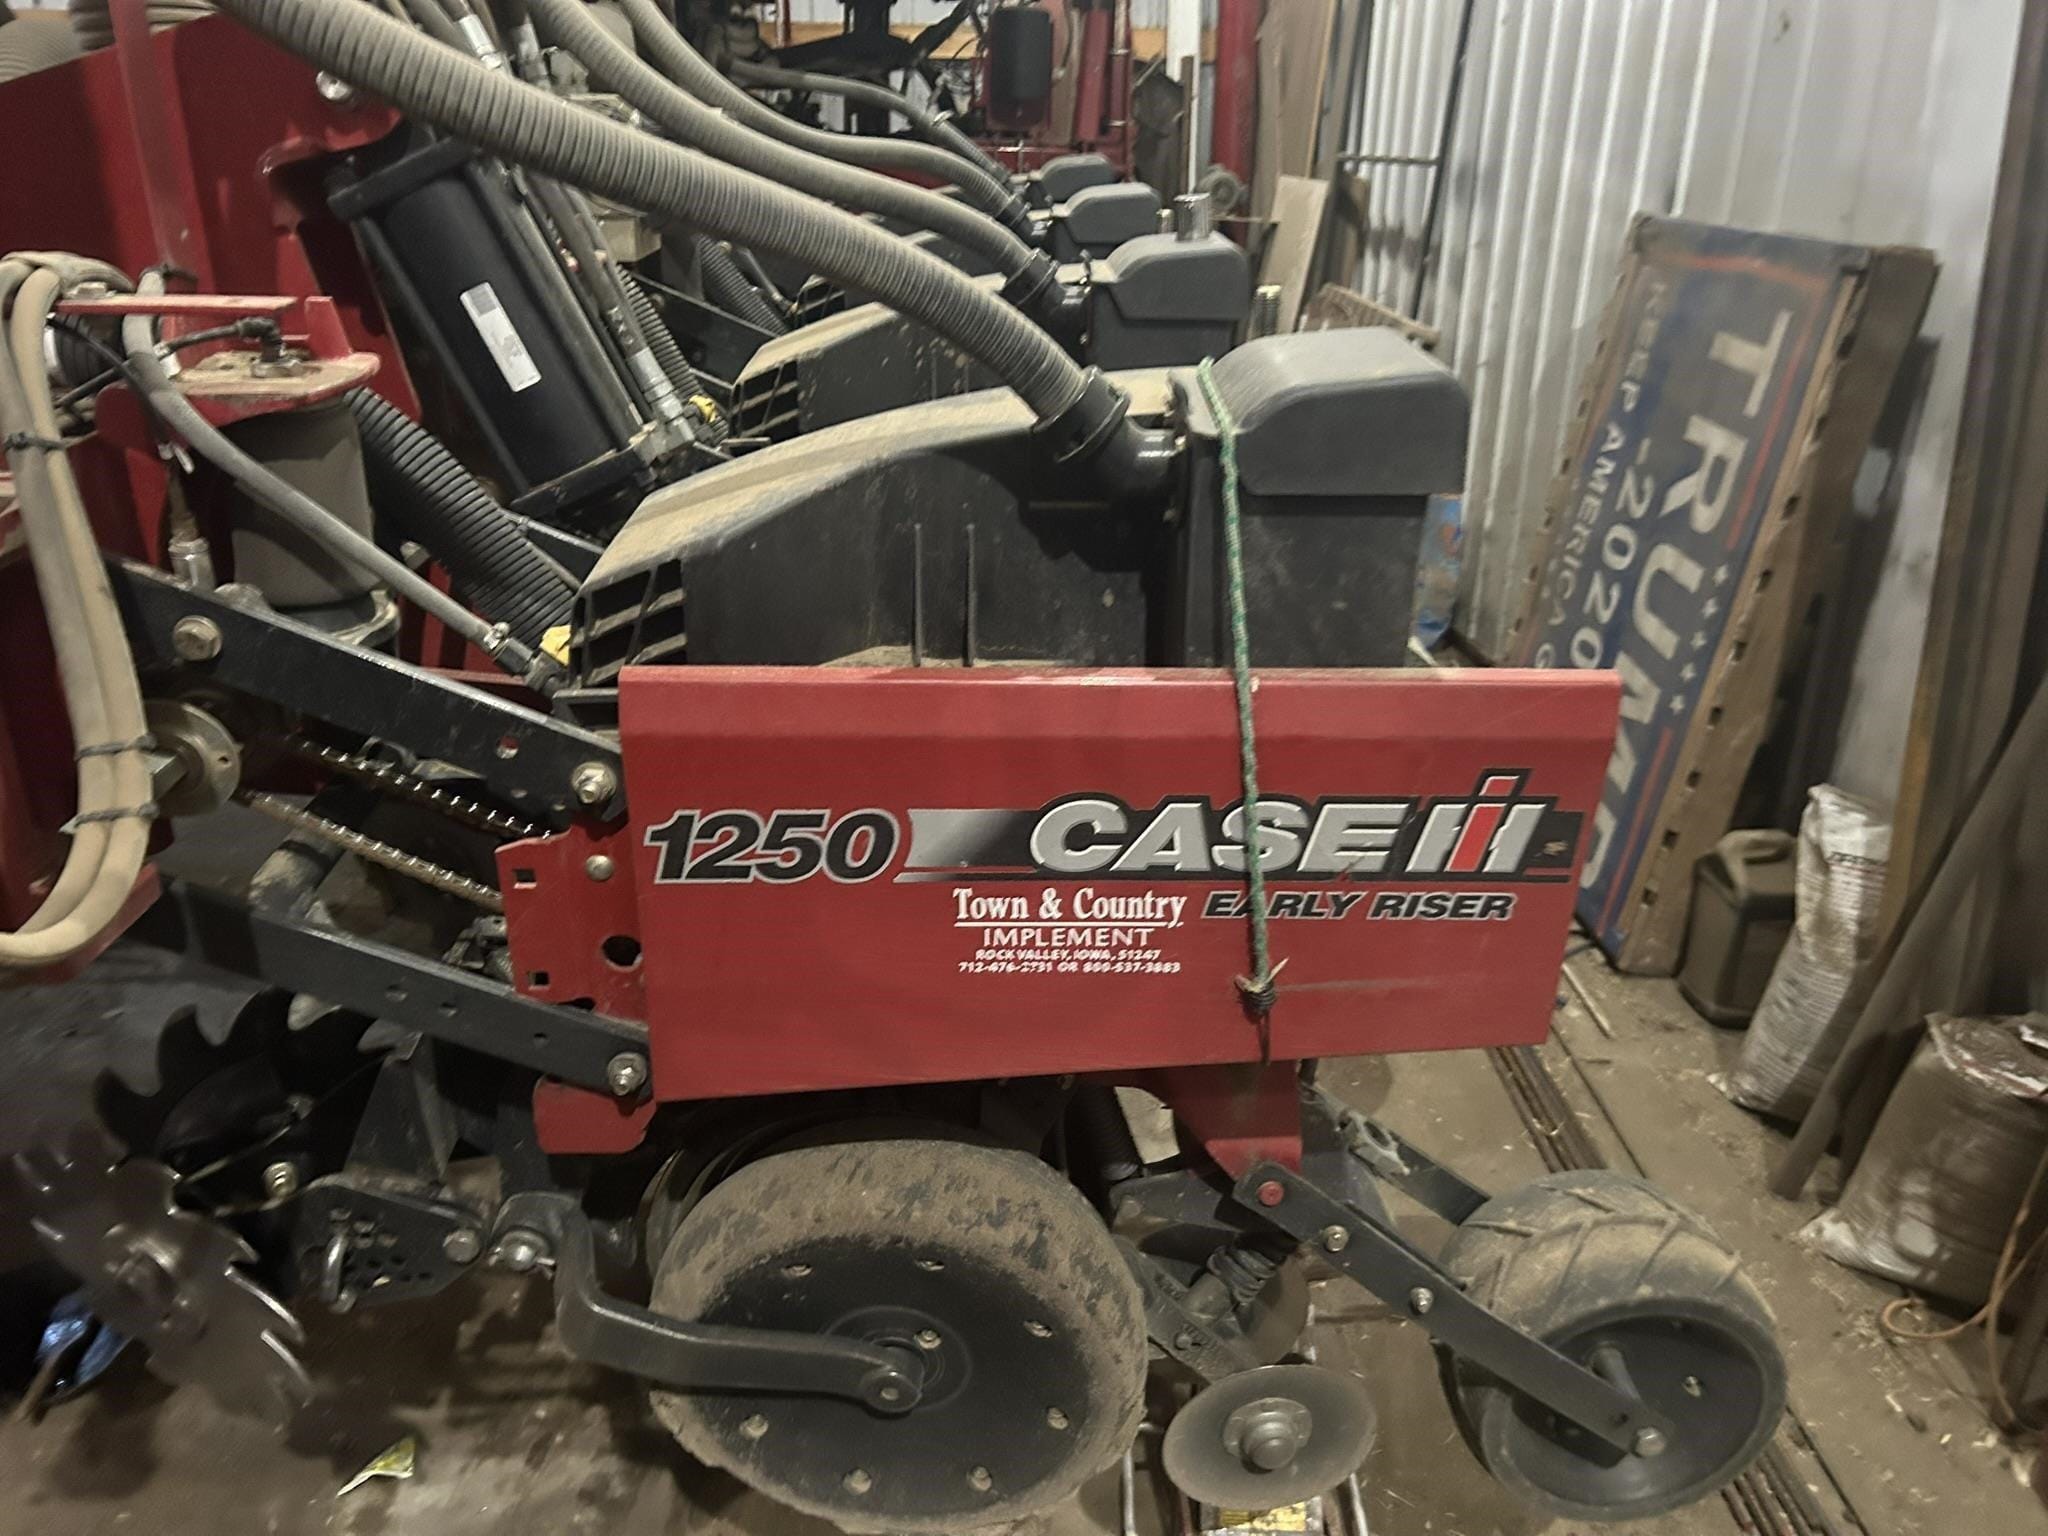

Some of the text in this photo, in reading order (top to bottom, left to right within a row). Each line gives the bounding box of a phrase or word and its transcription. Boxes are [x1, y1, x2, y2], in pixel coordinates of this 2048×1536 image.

[1546, 422, 1627, 626] AMERICA
[644, 808, 902, 885] 1250
[1030, 799, 1410, 874] CASE
[952, 887, 1187, 928] Town & Country
[1367, 892, 1517, 920] RISER
[983, 928, 1155, 947] IMPLEMENT
[1056, 961, 1079, 973] OR
